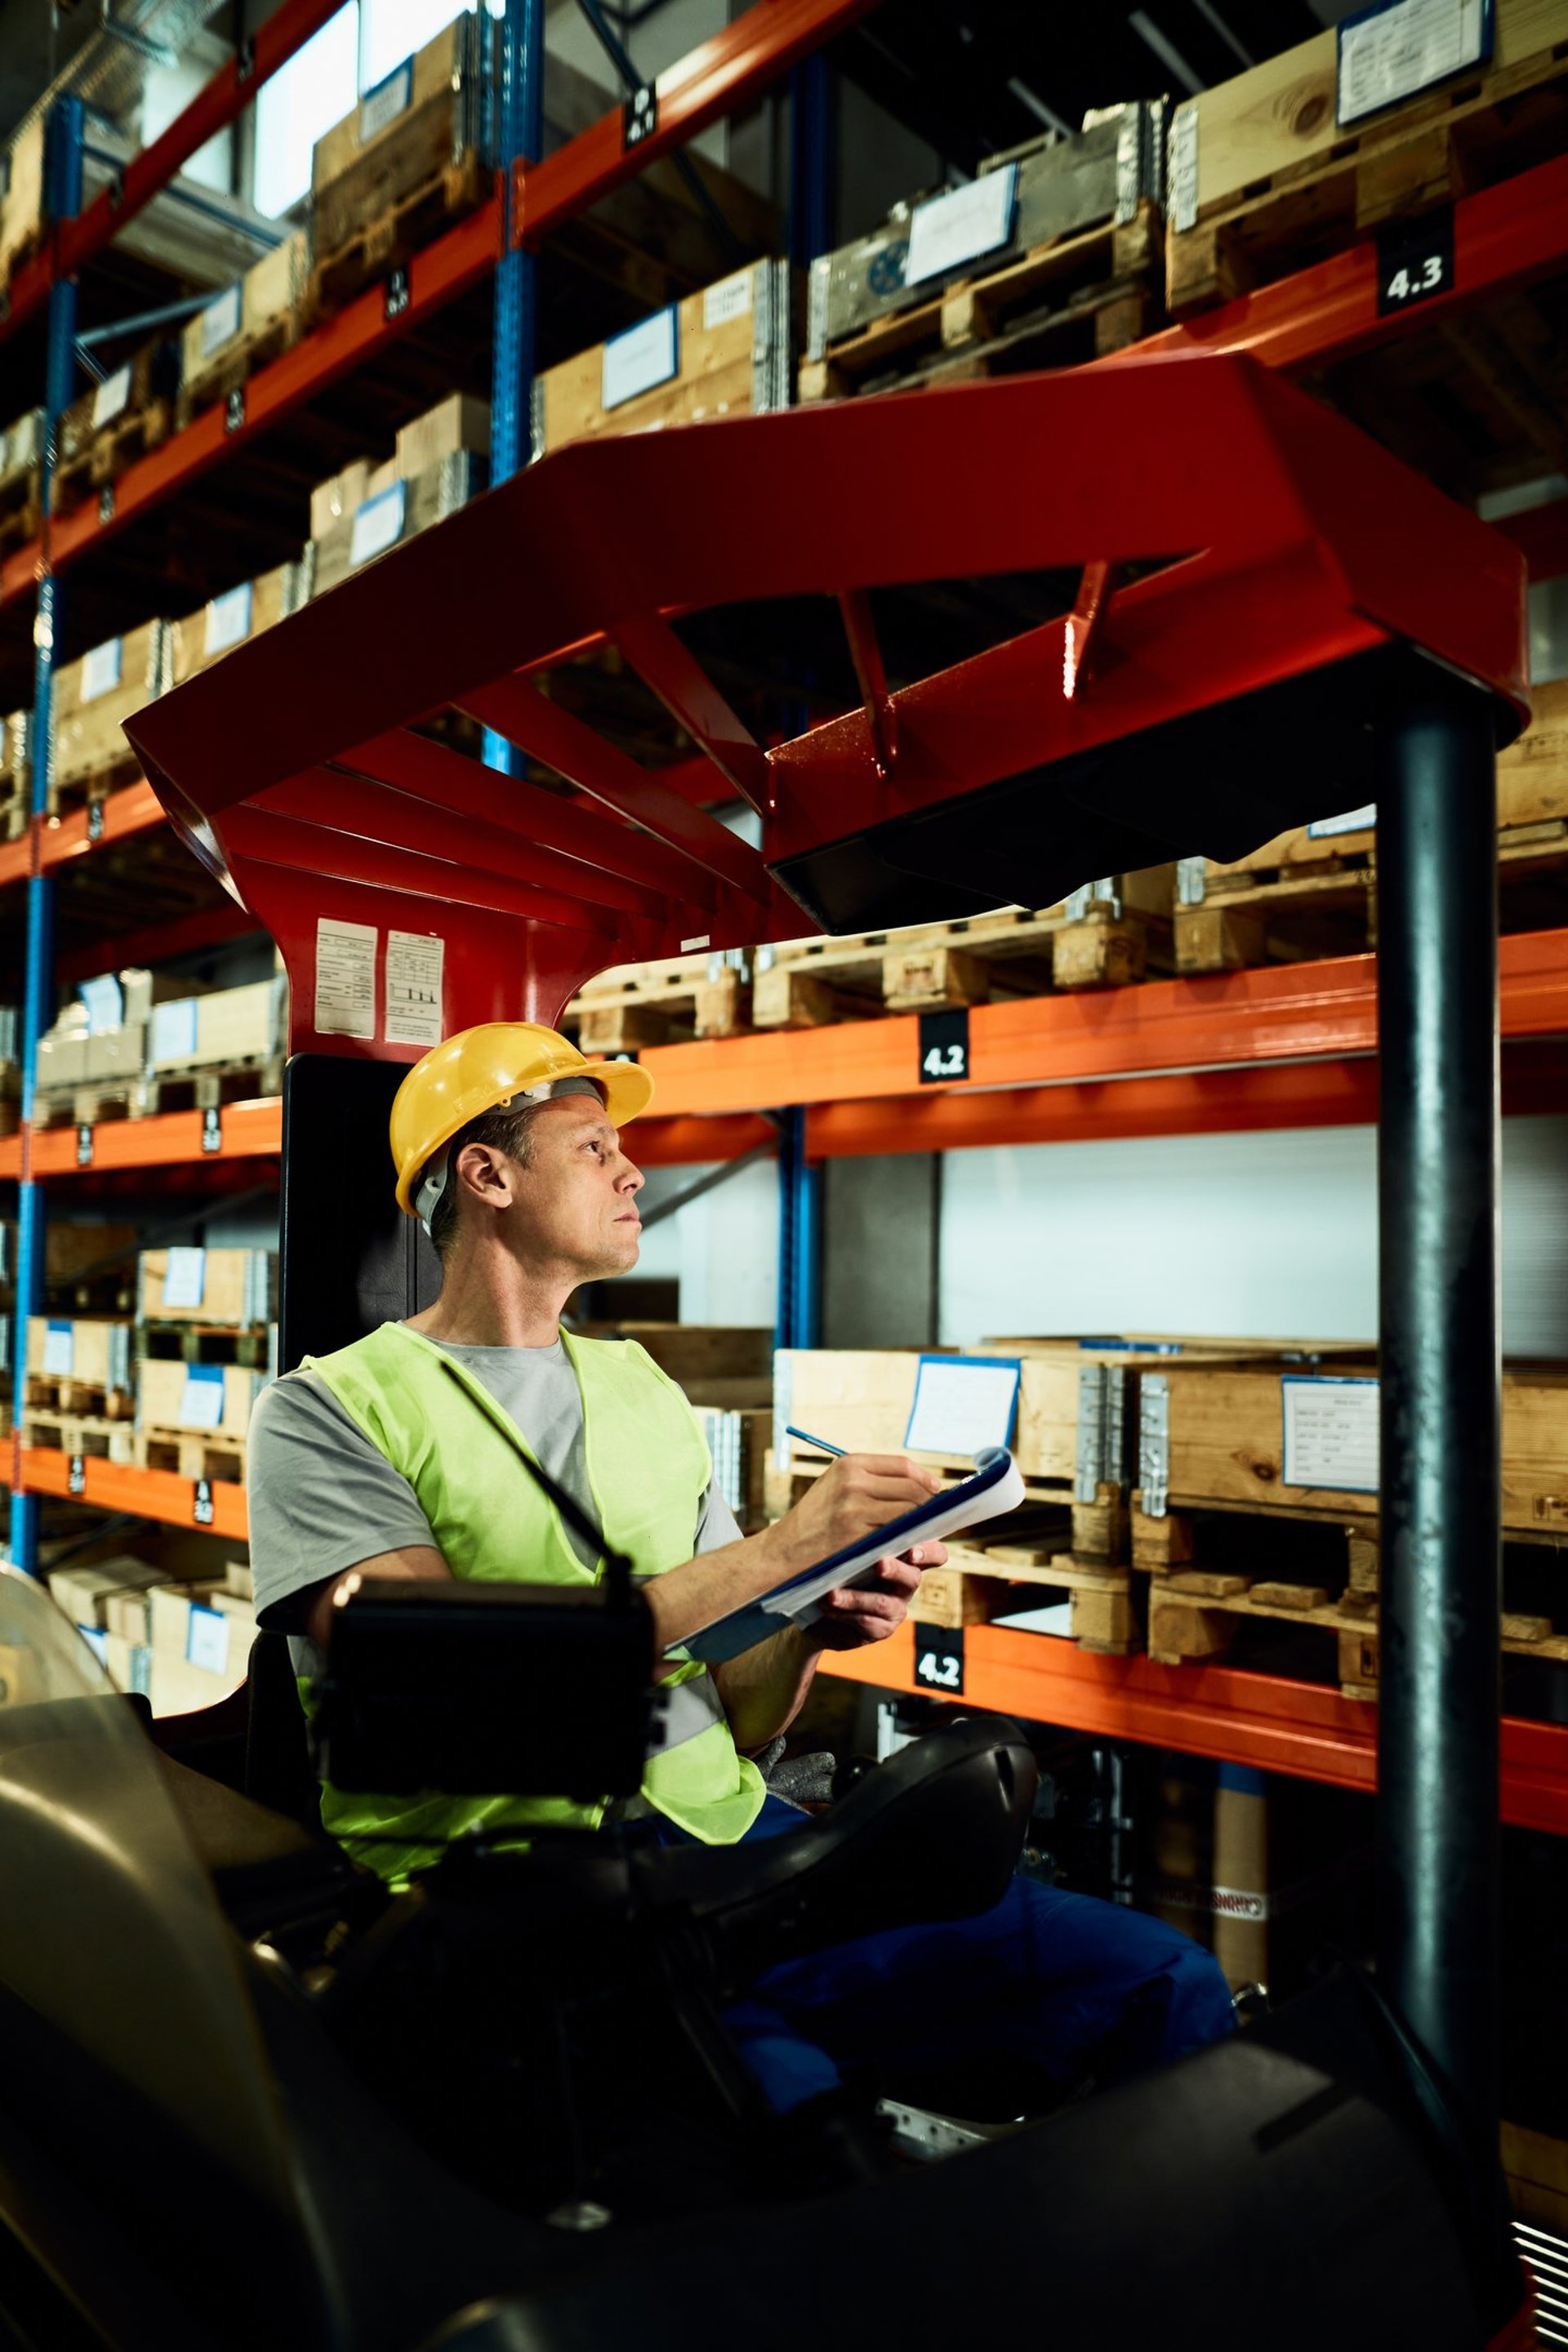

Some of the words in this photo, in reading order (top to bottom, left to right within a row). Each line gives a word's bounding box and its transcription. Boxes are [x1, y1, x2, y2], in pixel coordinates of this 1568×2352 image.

[1388, 255, 1441, 299] 4.3
[923, 1045, 964, 1075] 4.2
[918, 1653, 960, 1686] 4.2
